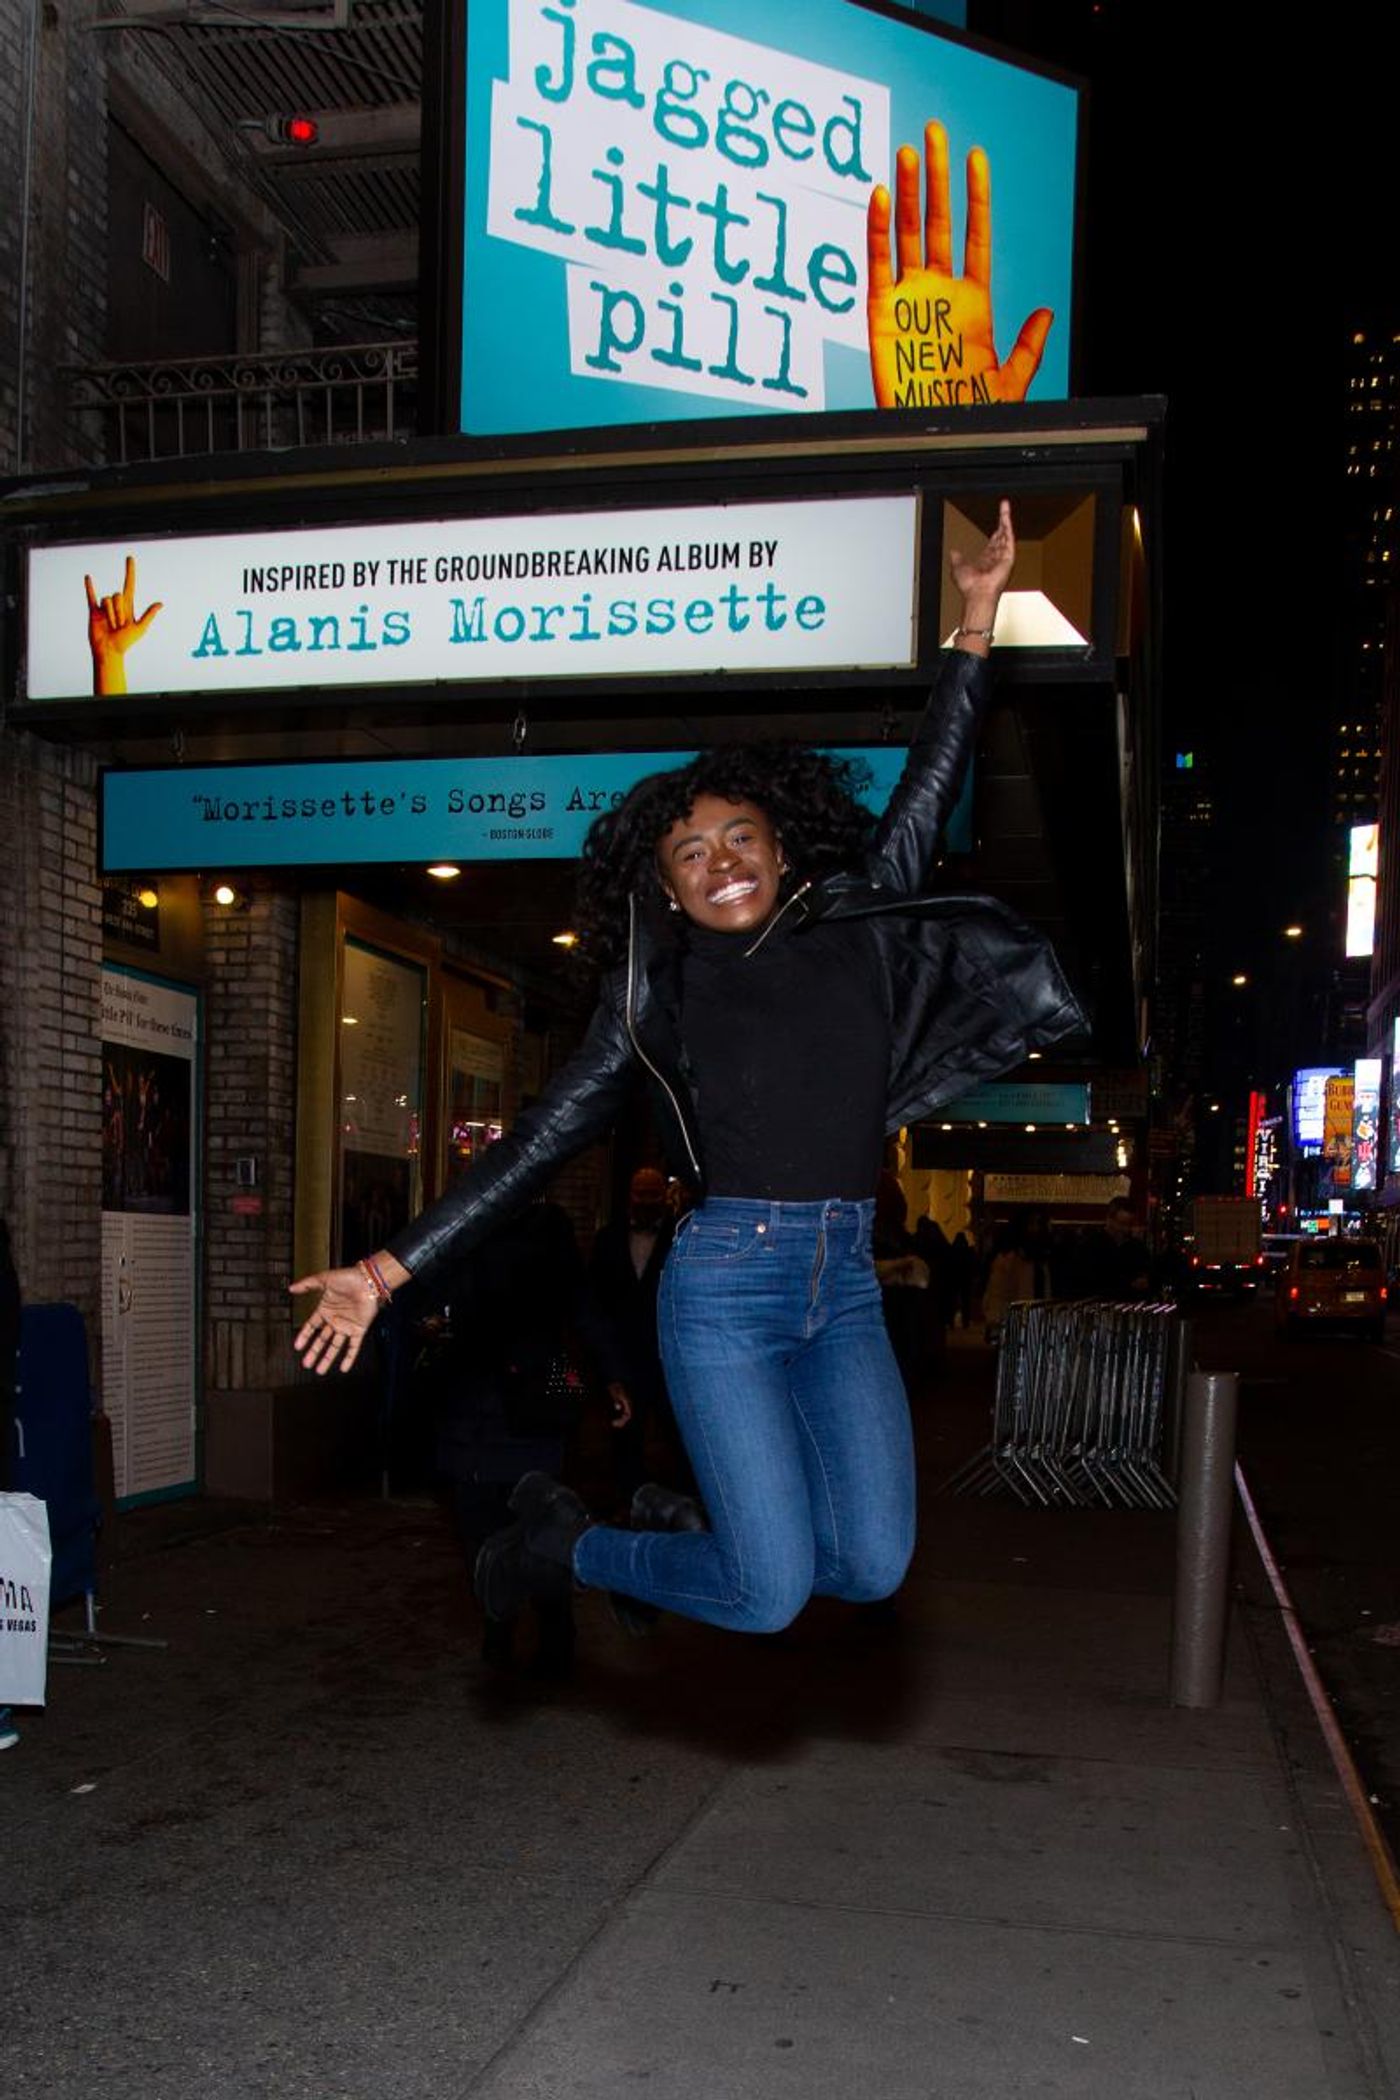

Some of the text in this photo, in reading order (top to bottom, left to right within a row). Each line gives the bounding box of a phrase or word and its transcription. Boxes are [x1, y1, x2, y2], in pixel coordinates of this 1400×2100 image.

[535, 0, 872, 183] jagged
[515, 117, 857, 314] little
[585, 282, 808, 397] pill
[895, 298, 953, 339] OUR
[896, 334, 963, 385] NEW
[894, 372, 991, 408] MUSICAL
[243, 541, 778, 594] INSPIRED BY THE GROUNDBREAKING ALBUM BY
[192, 583, 827, 658] Alanis Morissette
[447, 788, 546, 819] Songs
[566, 786, 627, 812] Are
[490, 827, 555, 841] BOSTON GLOBE
[7, 1619, 36, 1632] VEGAS
